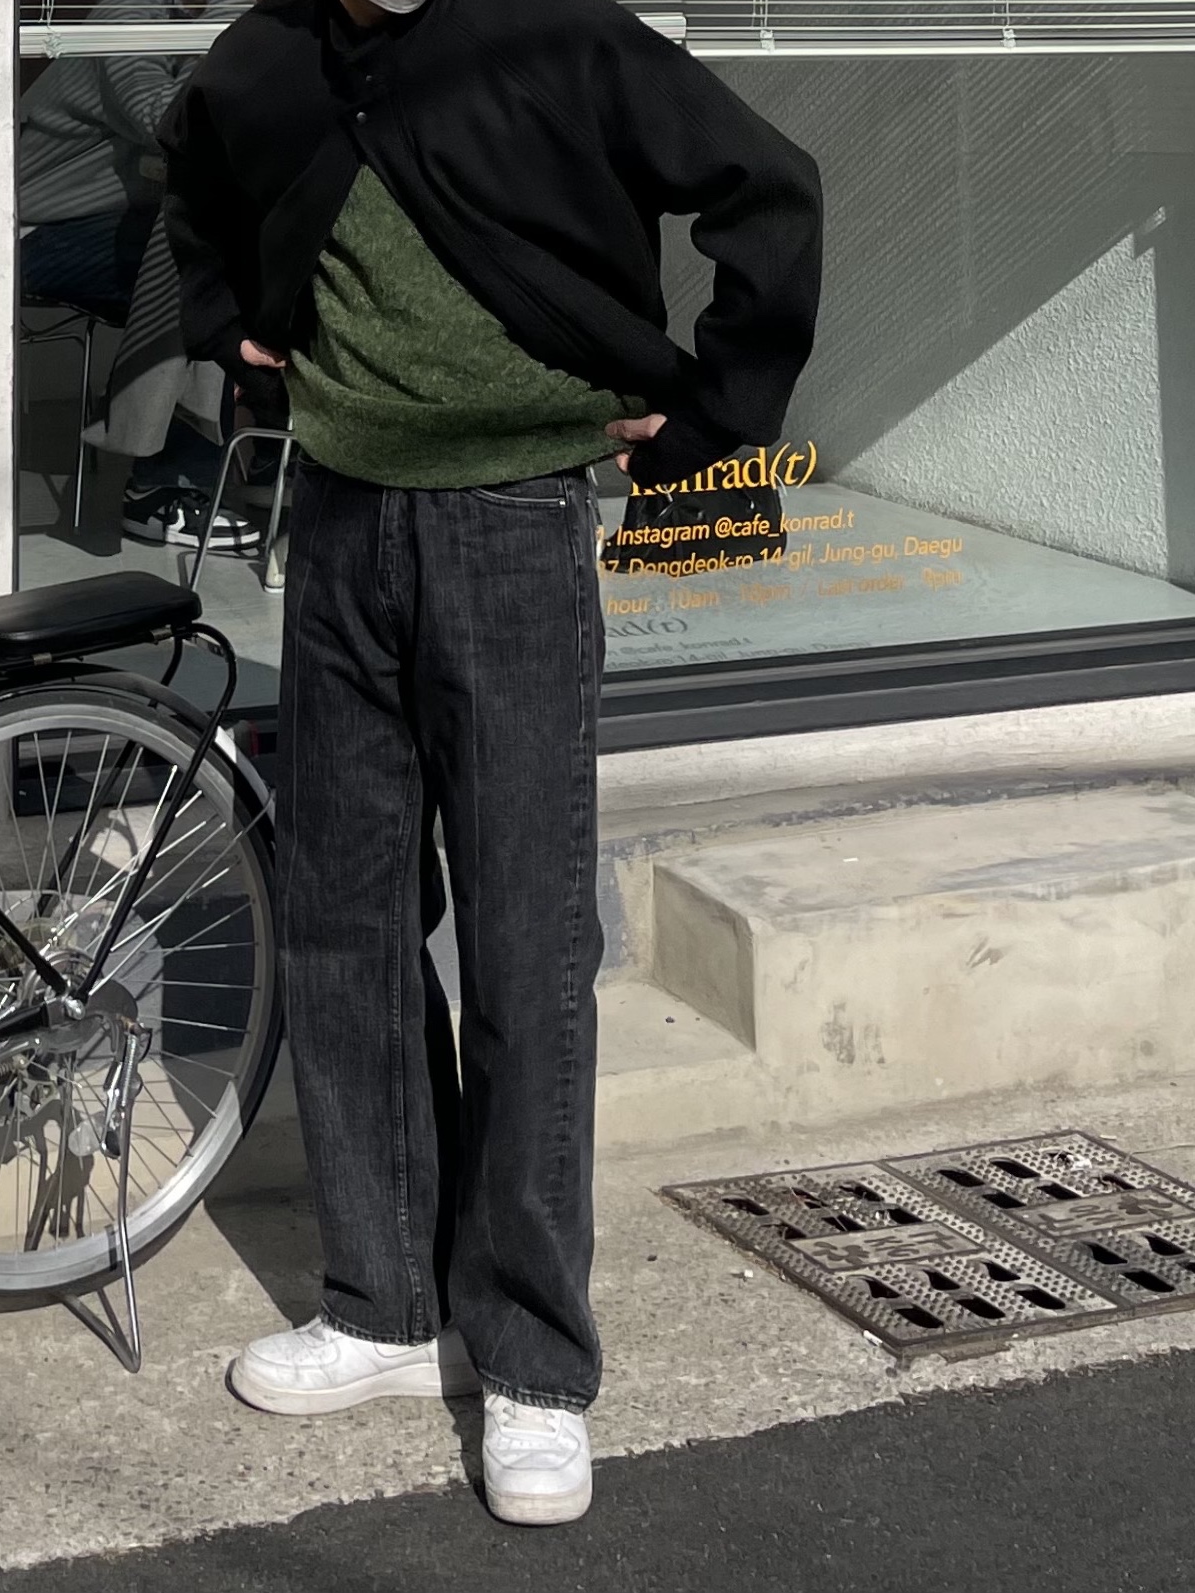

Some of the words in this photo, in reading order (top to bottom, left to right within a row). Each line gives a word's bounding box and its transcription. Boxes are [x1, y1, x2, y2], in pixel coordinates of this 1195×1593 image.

[617, 523, 710, 548] Instagram
[714, 508, 854, 538] @cafe_konrad.t
[628, 549, 754, 580] Dongdeok-ro
[818, 541, 898, 565] Jung-gu,
[904, 535, 963, 559] Daegu
